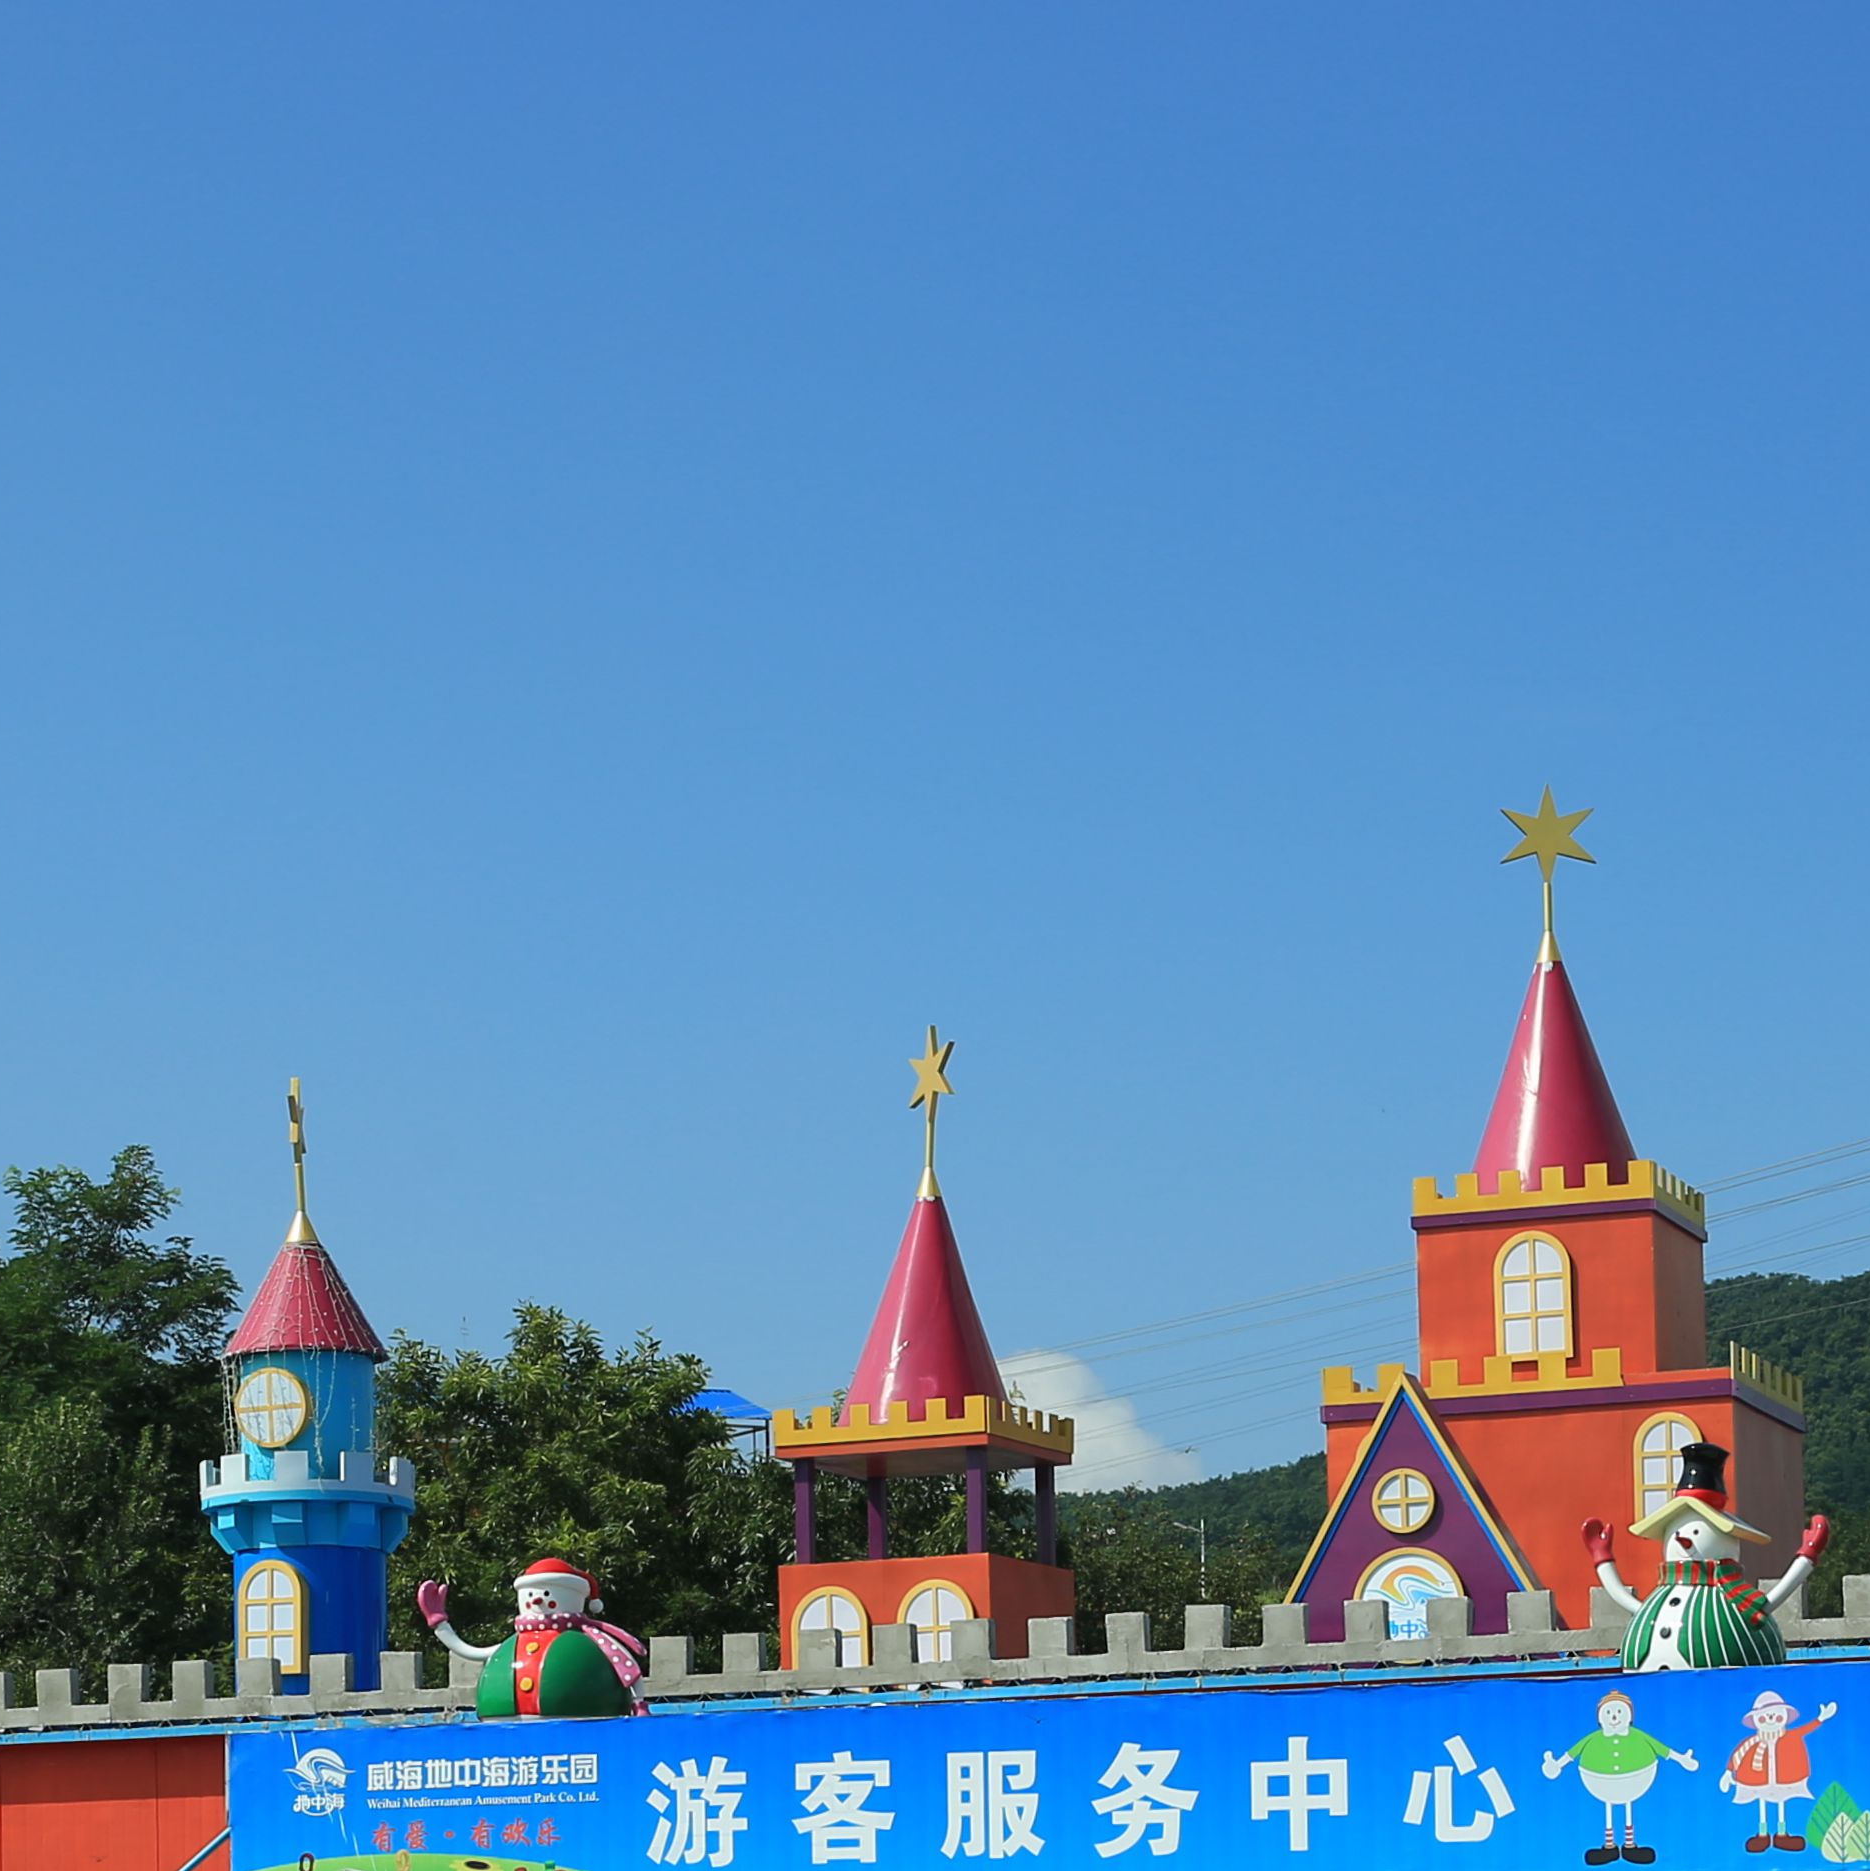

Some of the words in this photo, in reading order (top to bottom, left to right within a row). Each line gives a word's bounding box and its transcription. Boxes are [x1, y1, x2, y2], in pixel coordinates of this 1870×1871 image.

[366, 1753, 599, 1791] 威海地中海游乐园
[366, 1797, 401, 1809] Weihai
[401, 1796, 473, 1808] Mediterranean
[473, 1795, 532, 1806] Amusement
[533, 1792, 557, 1804] Park
[557, 1791, 576, 1803] Co.
[578, 1790, 600, 1802] Ltd.
[646, 1734, 1517, 1867] 游客服务中心
